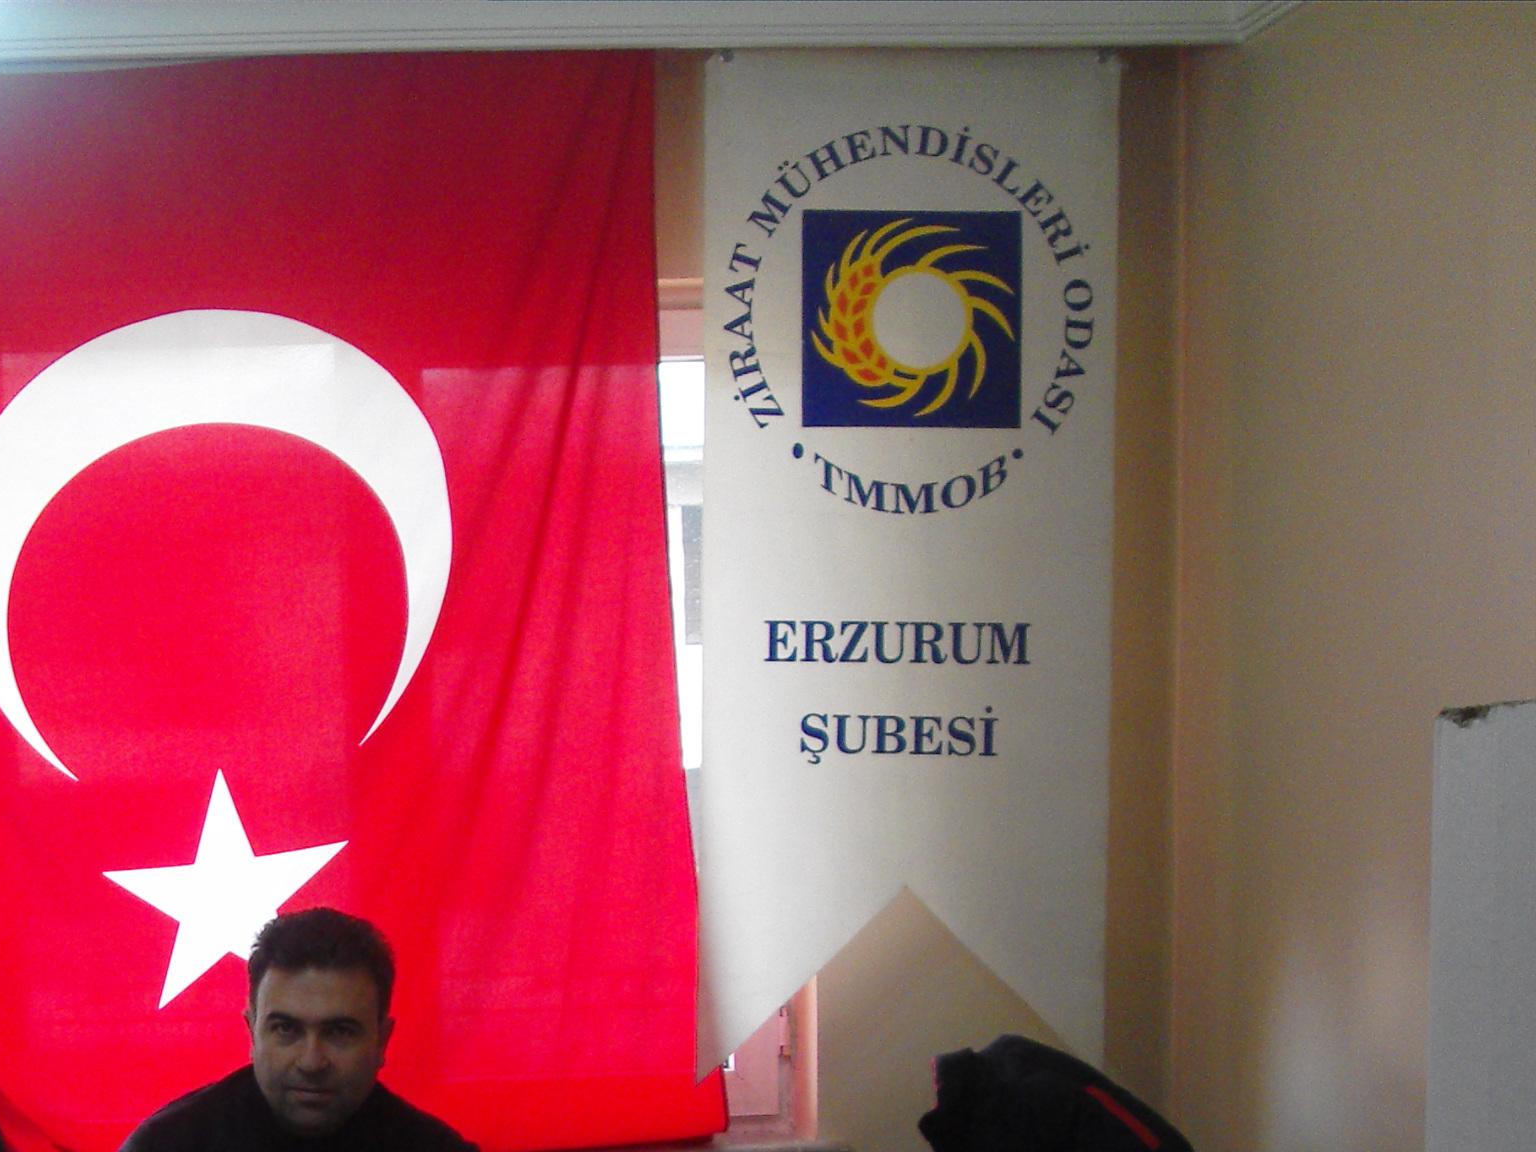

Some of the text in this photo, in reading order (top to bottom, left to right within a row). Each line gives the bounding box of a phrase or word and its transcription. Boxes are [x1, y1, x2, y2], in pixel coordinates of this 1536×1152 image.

[723, 124, 1094, 436] ZİRAAT MÜHENDİSLERİ ODASI
[814, 452, 1008, 515] TMMOB
[764, 619, 1032, 666] ERZURUM
[799, 704, 999, 765] ŞUBESİ
